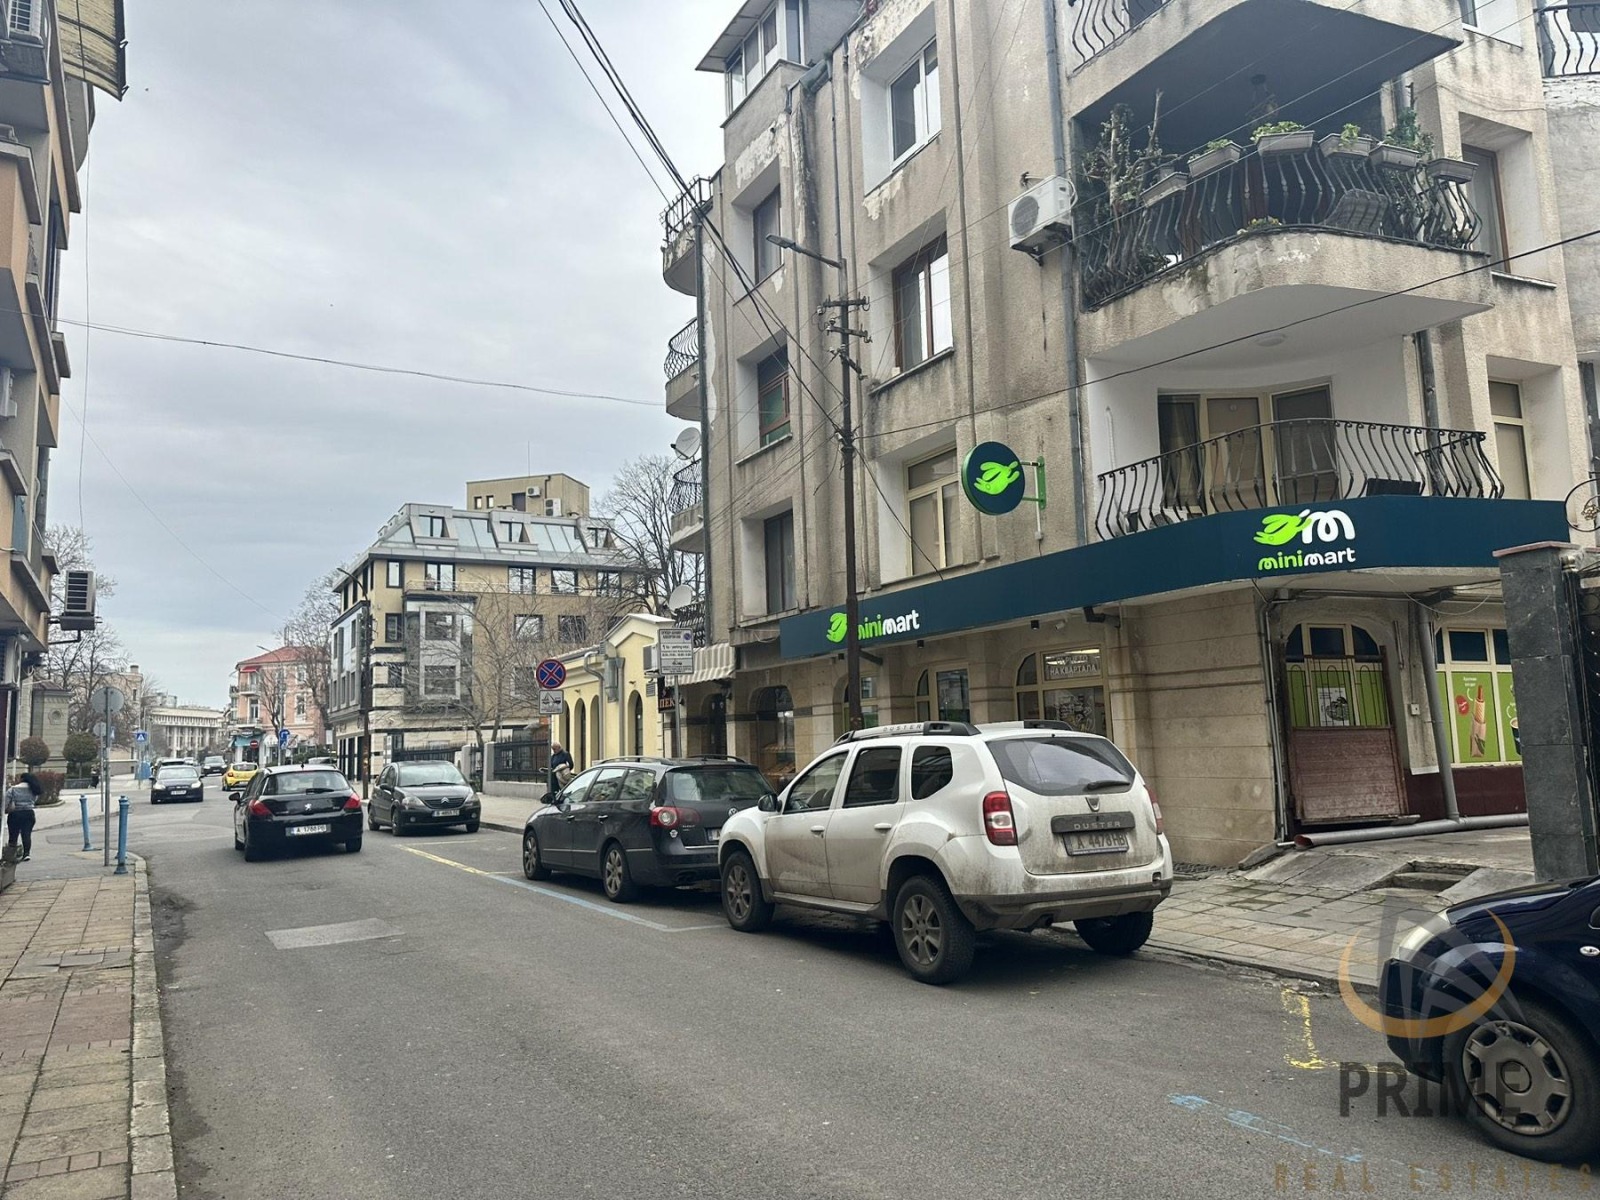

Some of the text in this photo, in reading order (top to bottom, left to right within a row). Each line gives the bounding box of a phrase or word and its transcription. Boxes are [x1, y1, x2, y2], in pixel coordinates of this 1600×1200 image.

[1258, 547, 1356, 571] minimart
[883, 724, 922, 732] DUSTER
[1073, 821, 1121, 830] DUSTER
